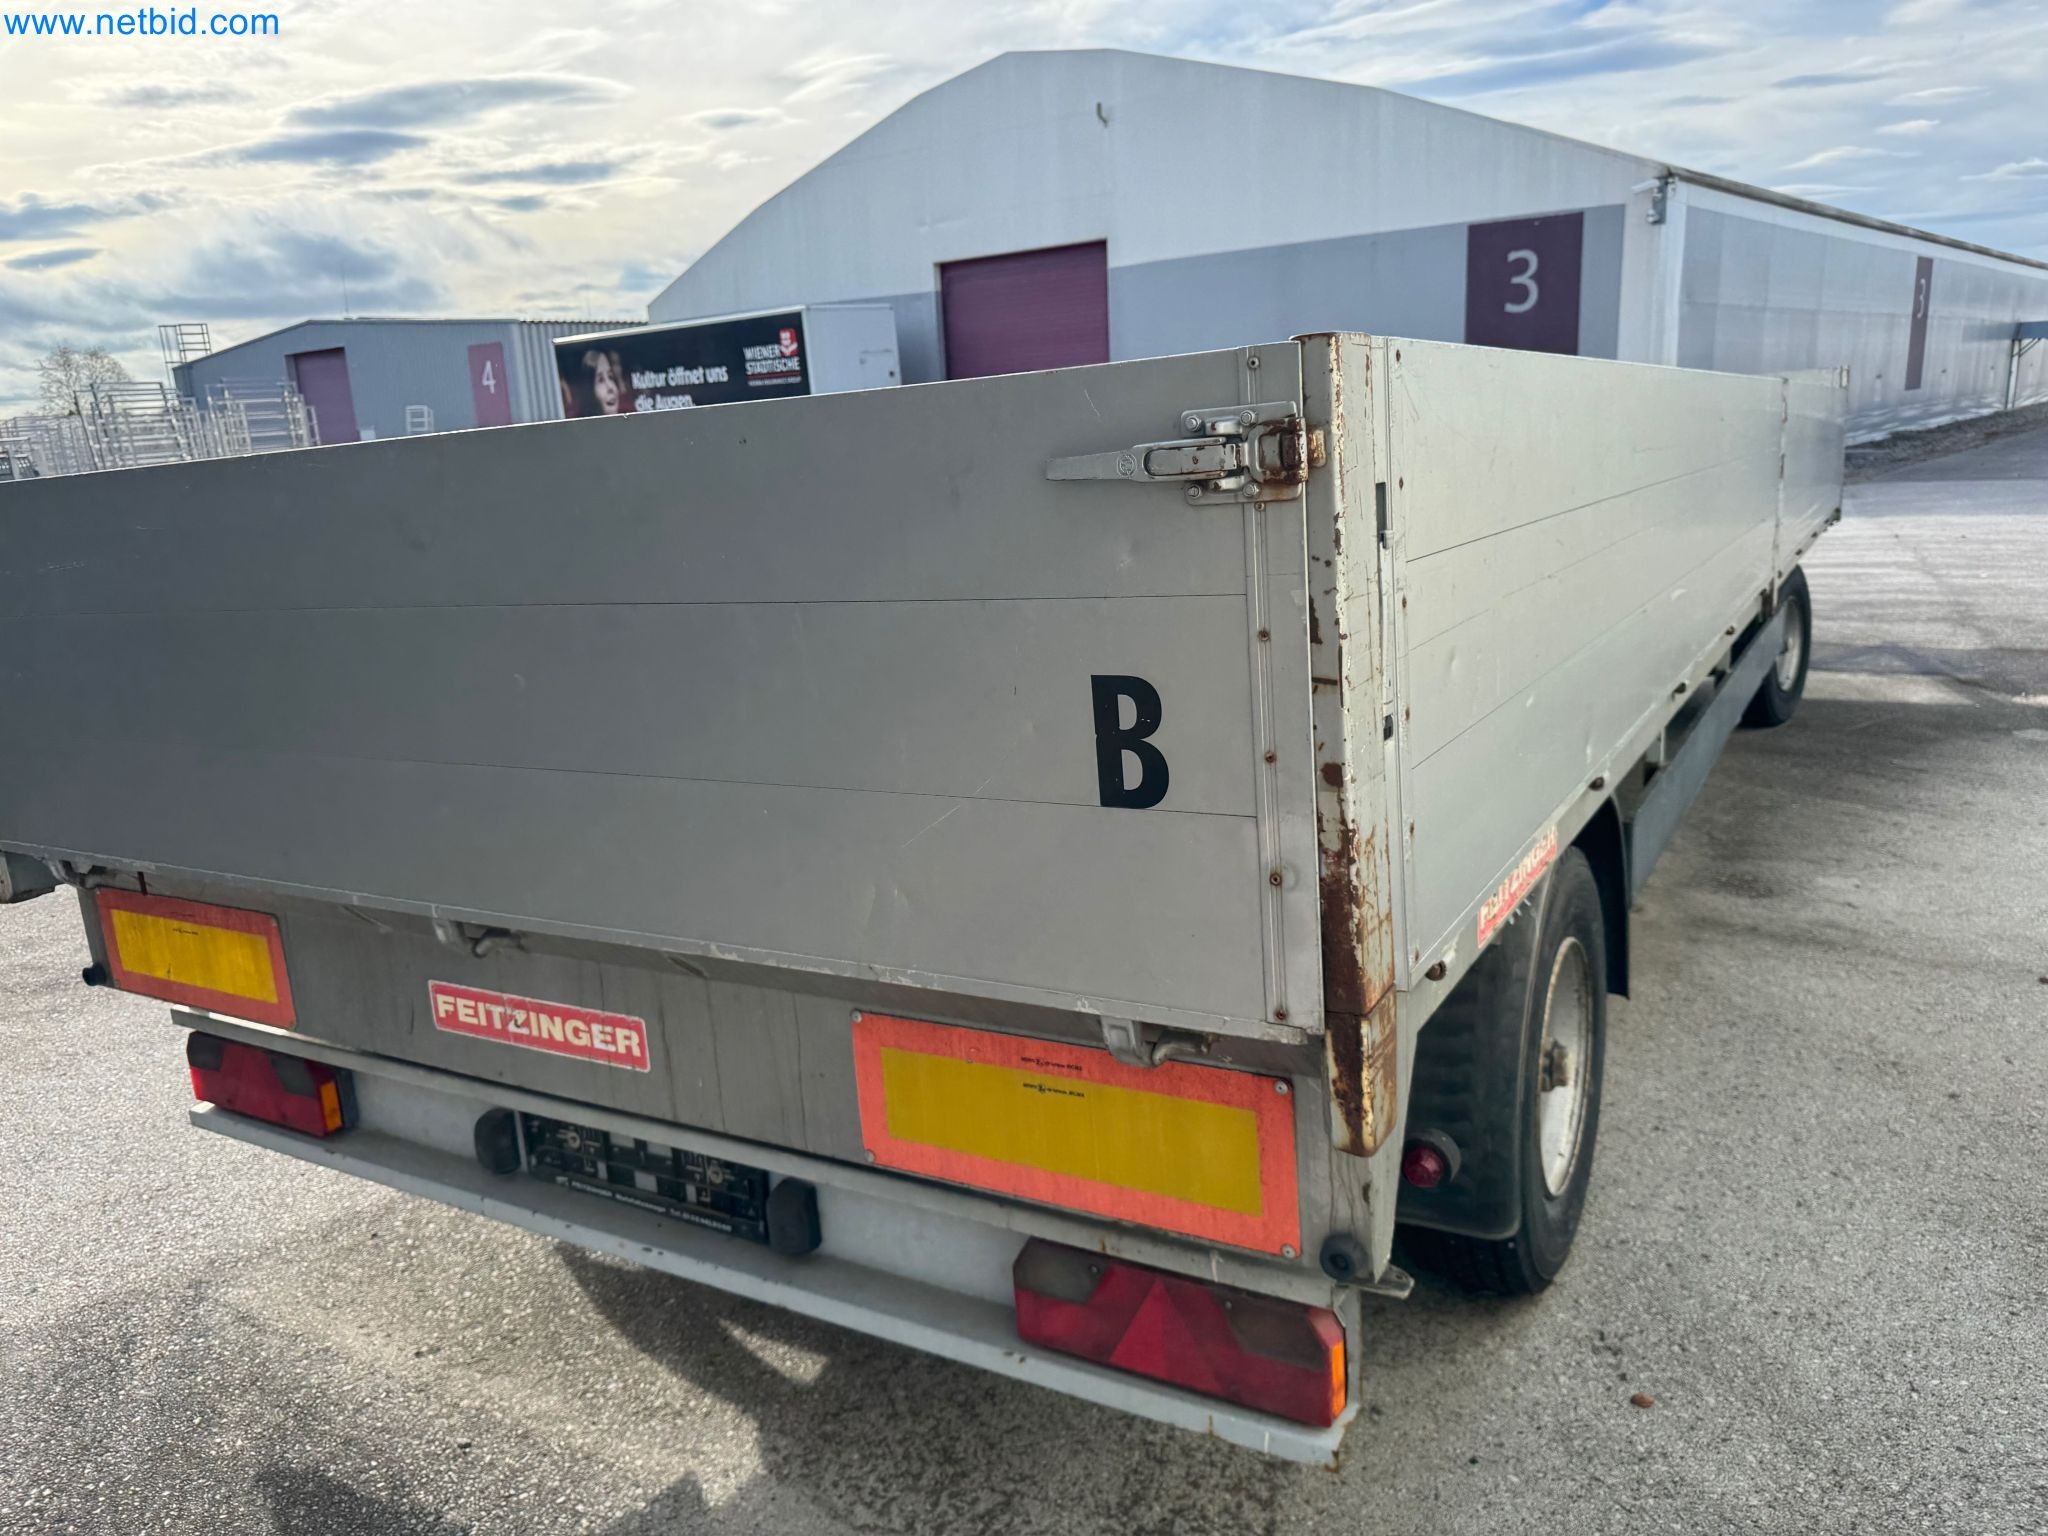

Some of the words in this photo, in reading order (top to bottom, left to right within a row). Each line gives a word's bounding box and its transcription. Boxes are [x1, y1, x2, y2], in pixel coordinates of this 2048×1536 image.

[1504, 248, 1539, 313] 3
[1917, 278, 1926, 320] 3
[743, 343, 780, 361] WIENER
[482, 360, 496, 394] 4
[631, 370, 667, 390] Kultur
[667, 365, 705, 387] öffnet
[704, 366, 729, 384] uns
[635, 393, 655, 411] die
[1090, 674, 1170, 809] B
[435, 993, 643, 1059] FEITZINGER
